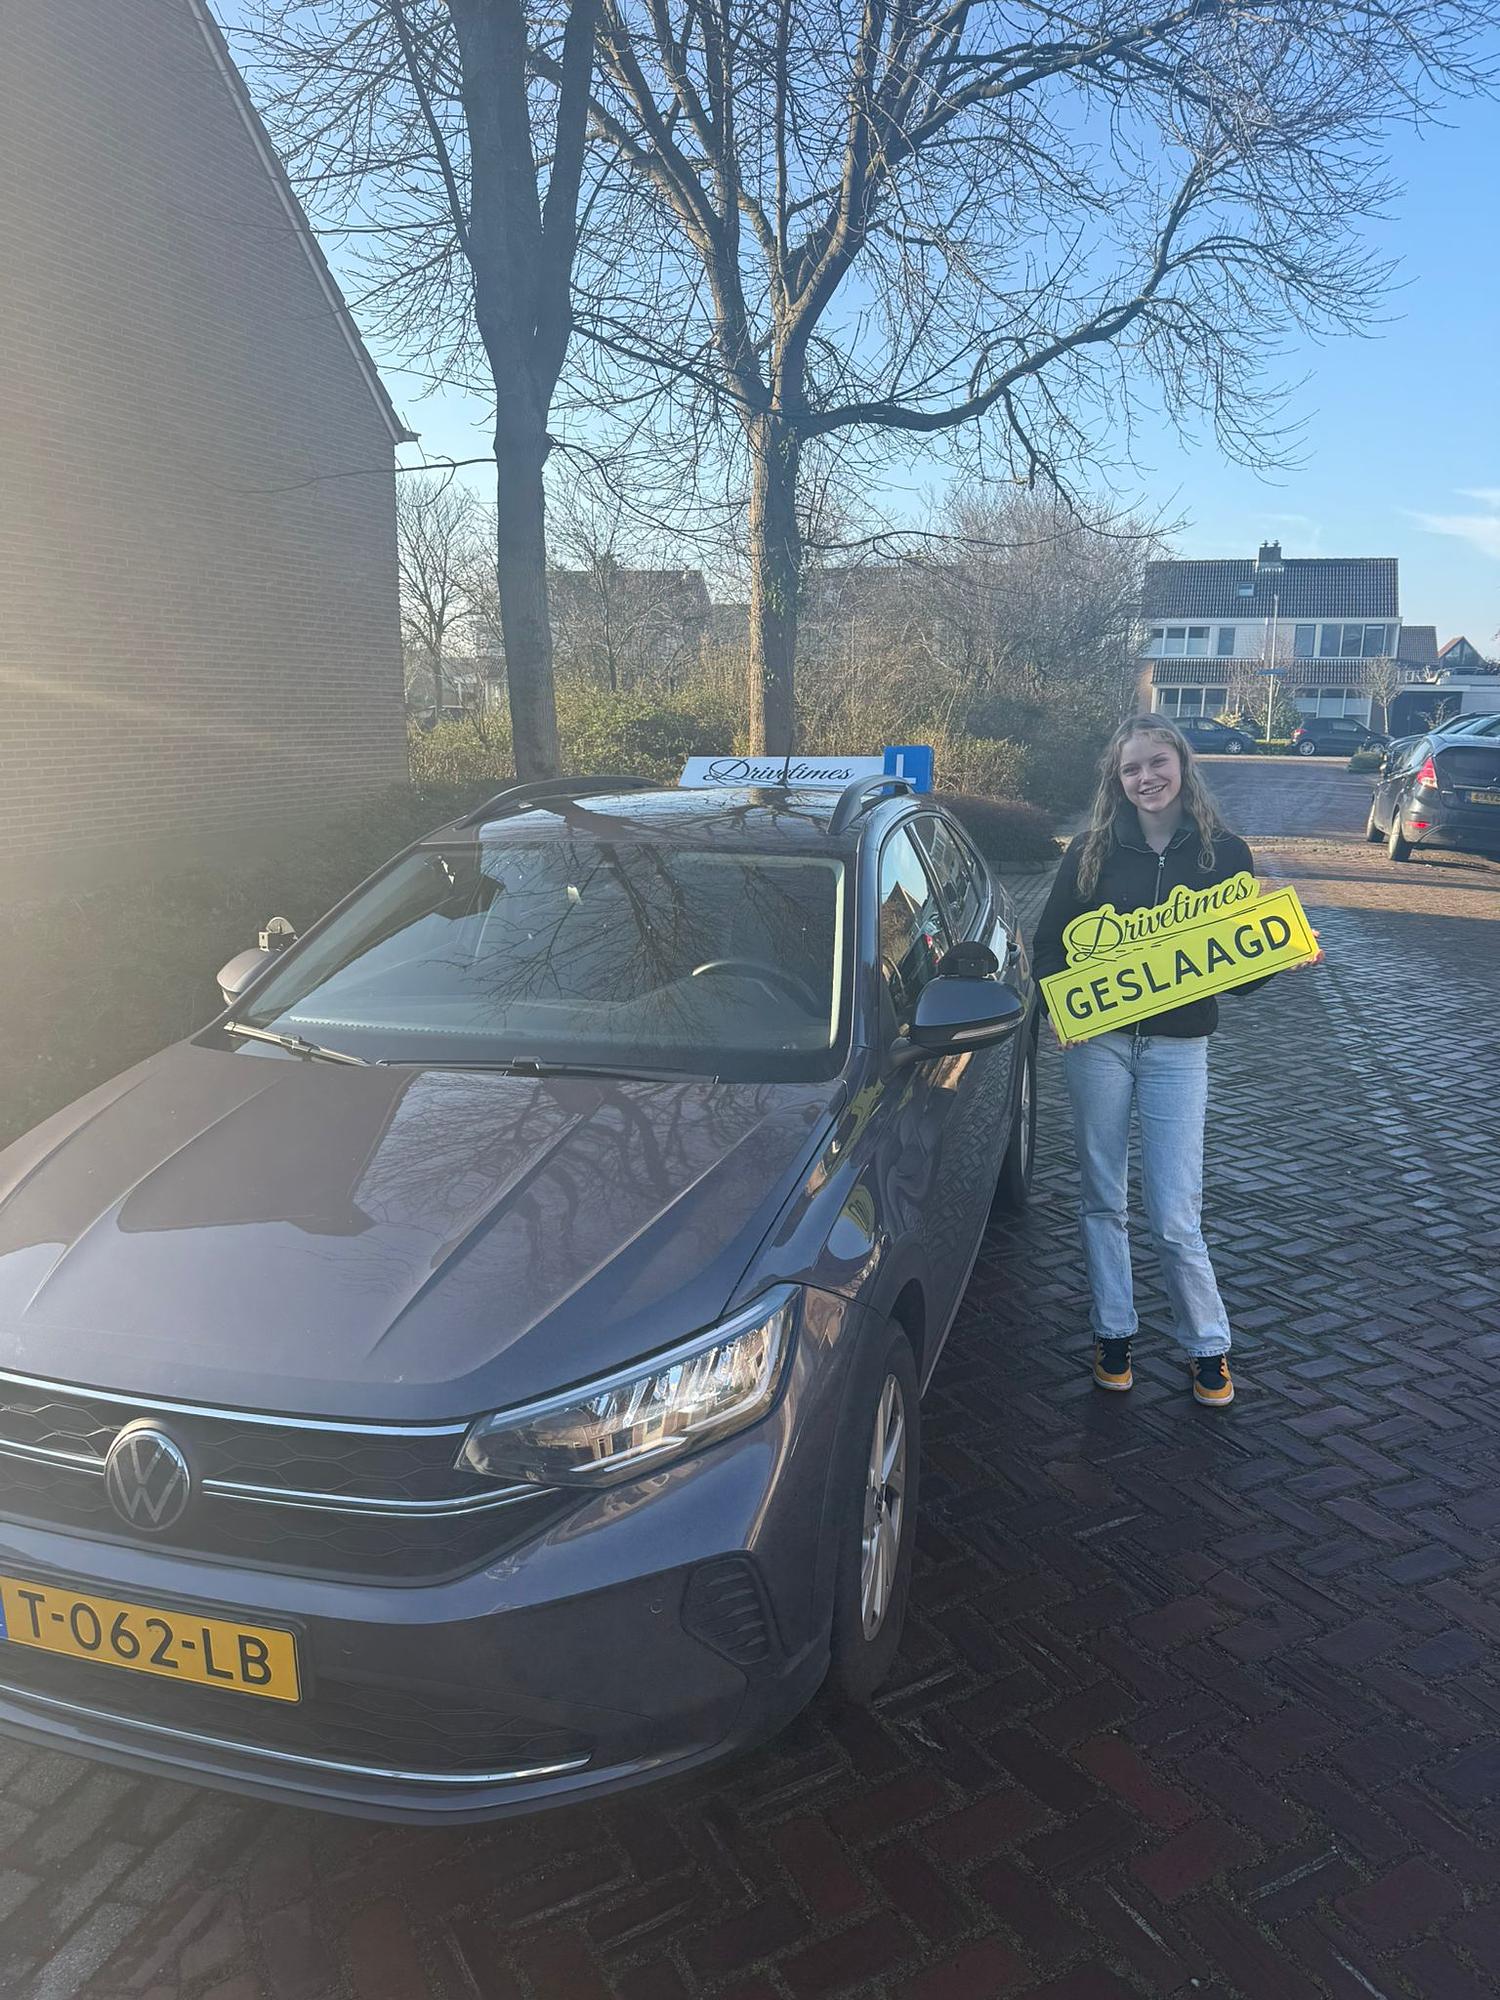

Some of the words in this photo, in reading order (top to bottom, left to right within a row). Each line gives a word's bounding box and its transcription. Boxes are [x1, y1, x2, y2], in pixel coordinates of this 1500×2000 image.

[703, 758, 854, 785] Drivetimes
[896, 753, 916, 784] L
[1068, 877, 1254, 962] Drivetimes
[1065, 915, 1292, 1020] GESLAAGD
[17, 1589, 272, 1685] T-062-LB
